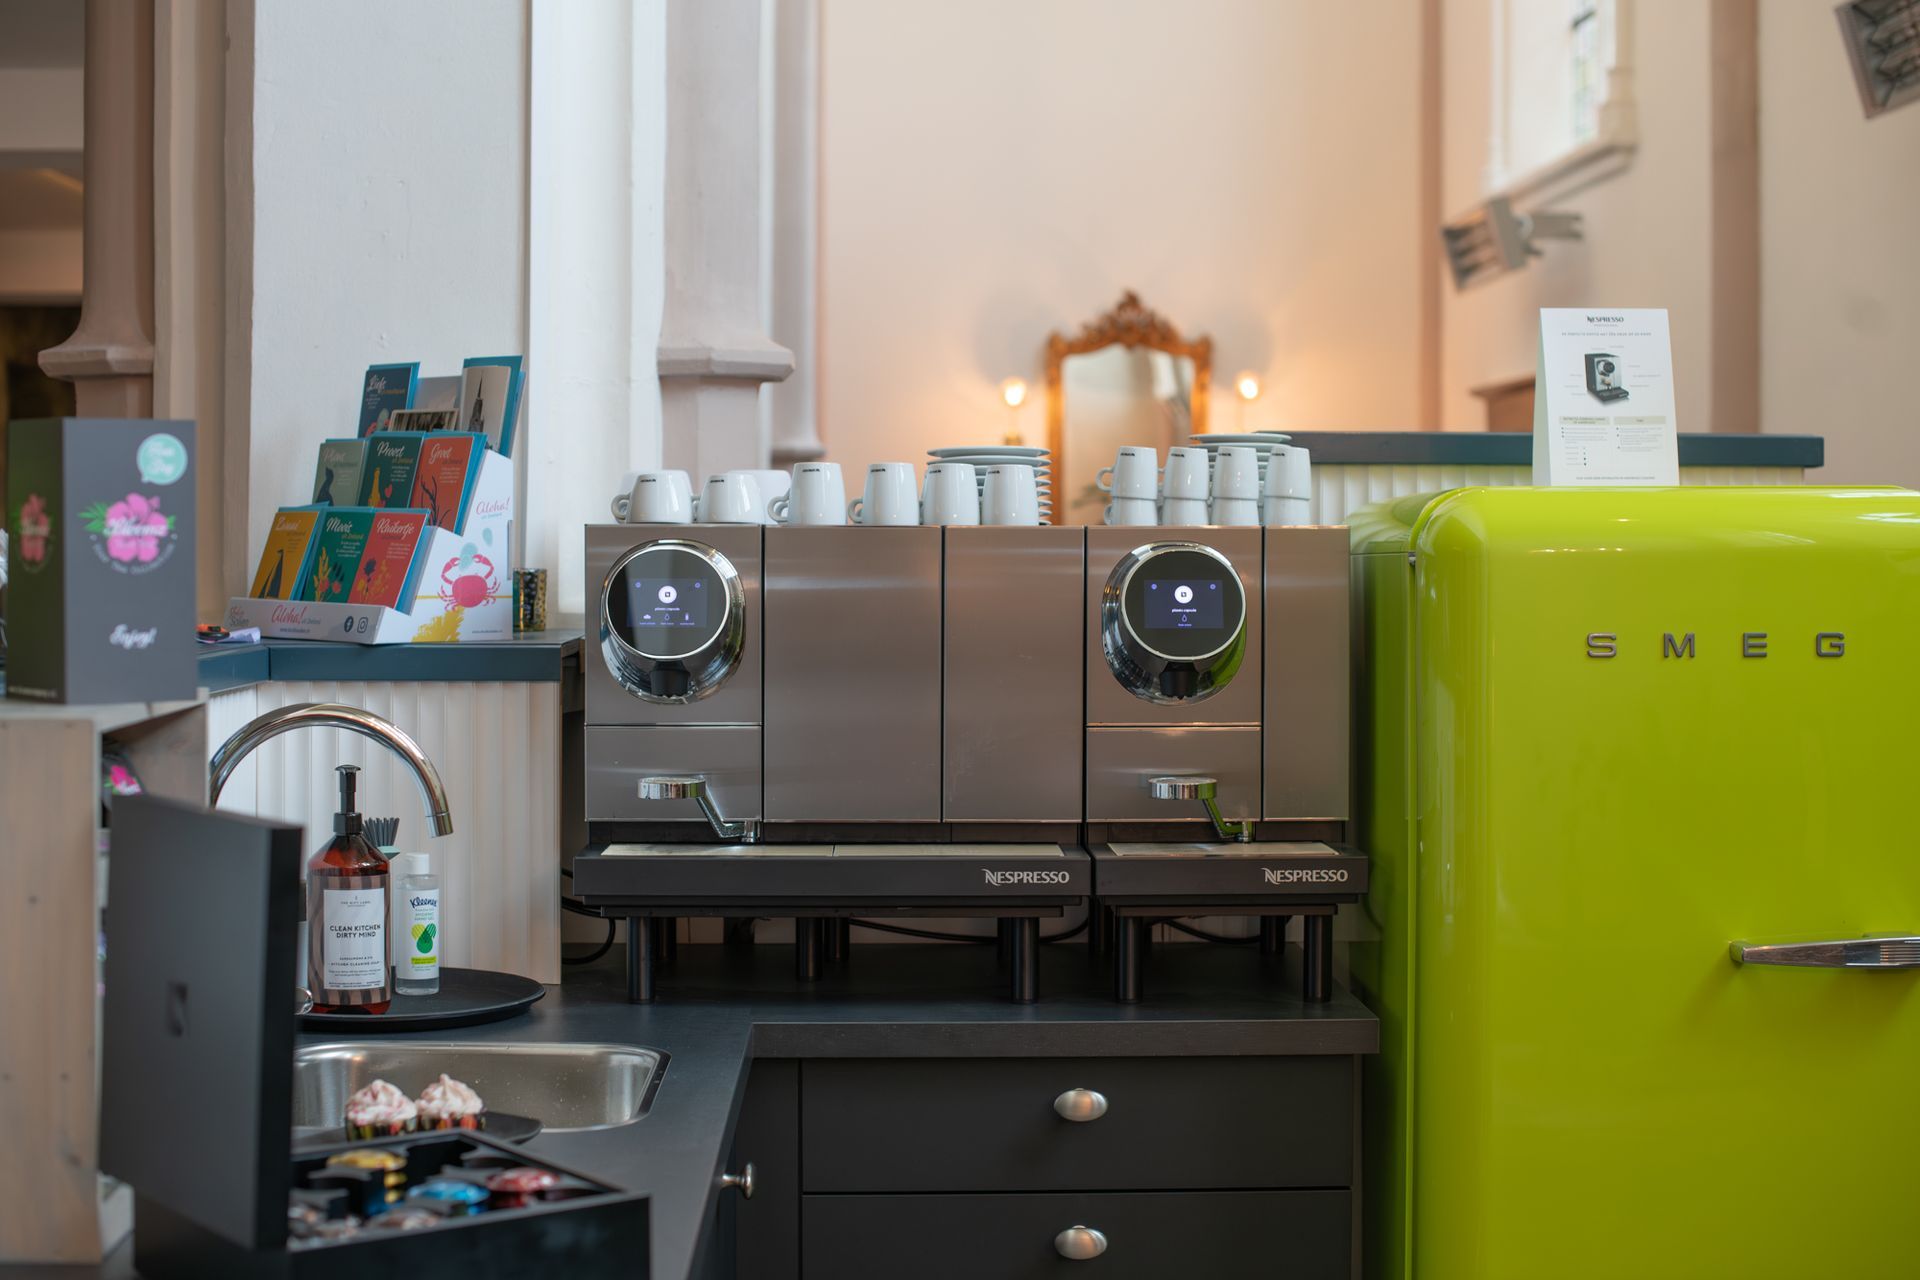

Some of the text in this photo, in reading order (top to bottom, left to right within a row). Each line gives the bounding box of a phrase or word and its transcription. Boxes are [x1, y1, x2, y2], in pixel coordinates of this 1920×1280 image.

[1587, 315, 1624, 323] NESPRESSO
[376, 441, 405, 458] Proost
[476, 496, 511, 515] Aloha!
[271, 604, 307, 625] Aloha!
[109, 623, 157, 650] Enjoy!
[981, 868, 1070, 886] NESPRESSO
[1260, 867, 1349, 885] NESPRESSO
[354, 924, 381, 932] KITCHEN
